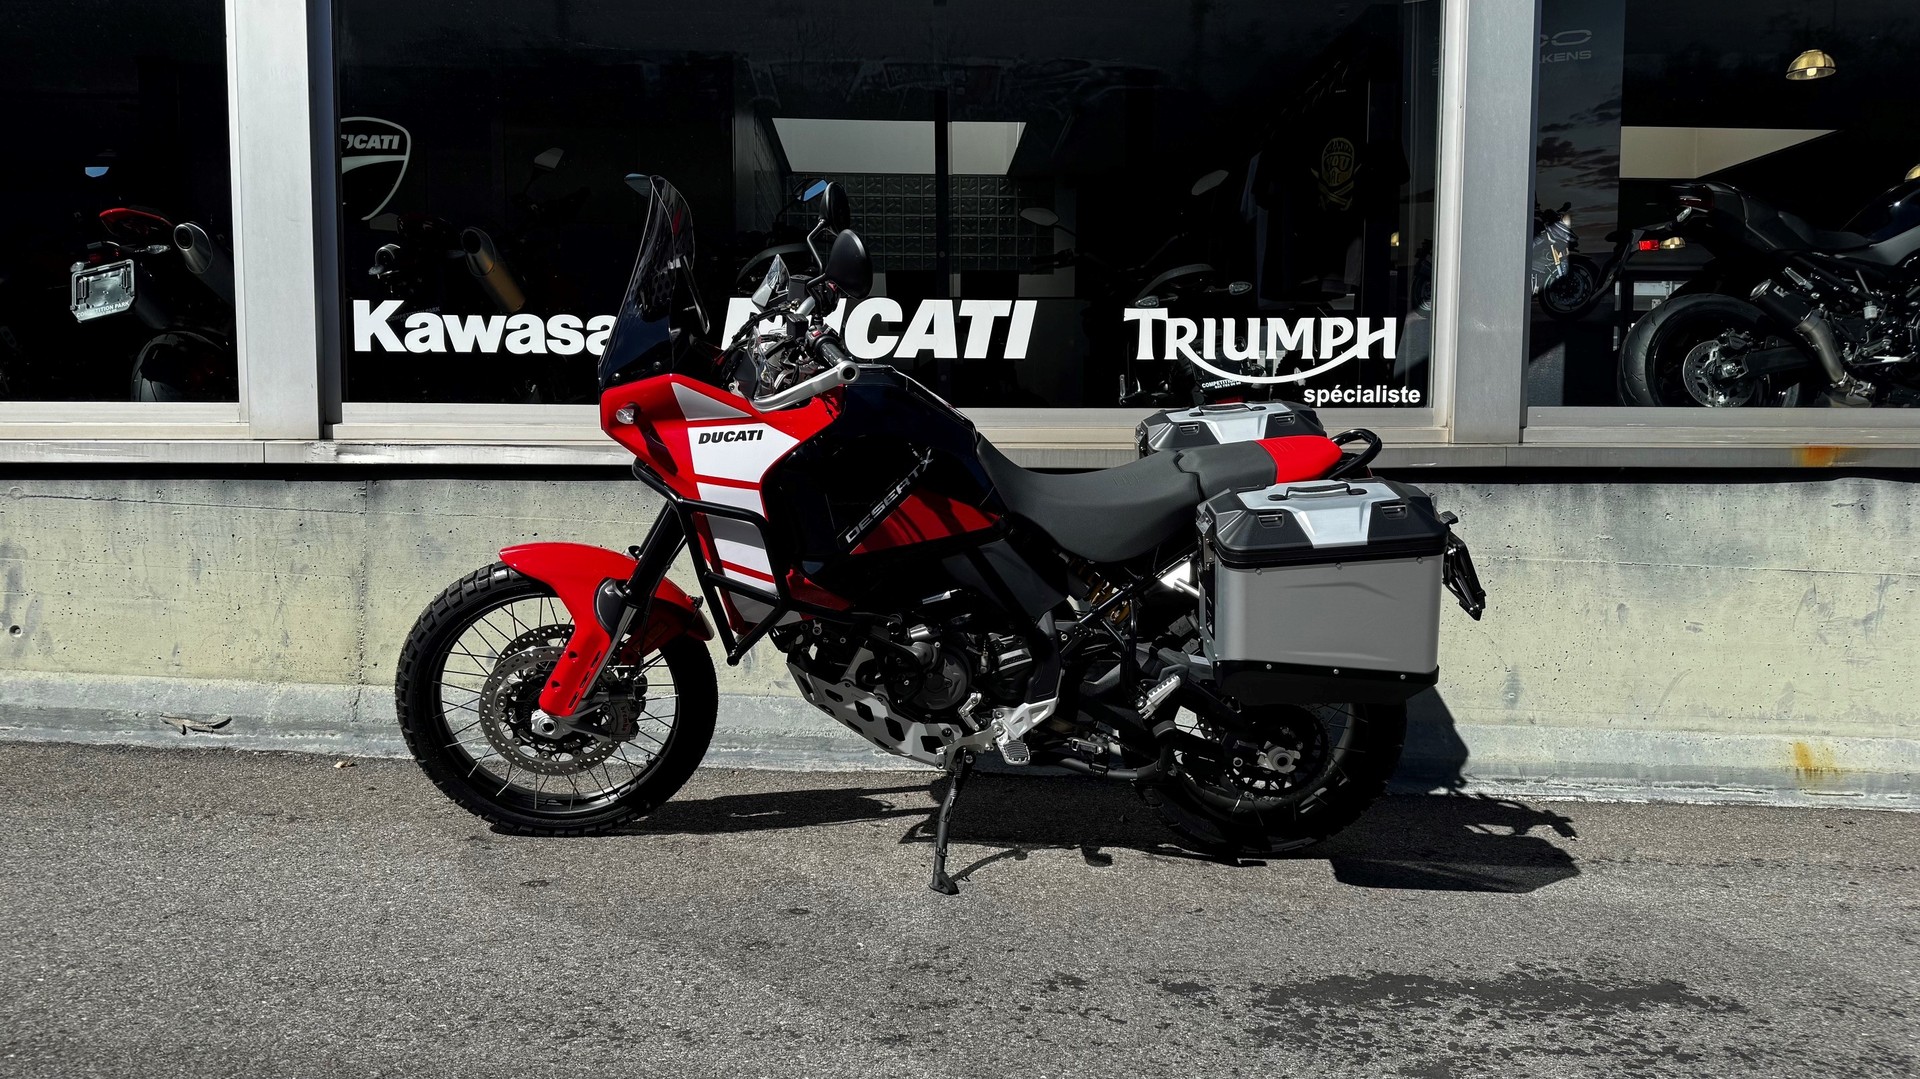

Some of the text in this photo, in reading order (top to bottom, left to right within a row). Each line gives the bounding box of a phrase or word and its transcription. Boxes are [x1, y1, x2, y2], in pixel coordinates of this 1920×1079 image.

[1123, 308, 1397, 384] TRIUMPH
[1303, 385, 1421, 406] spécialiste
[698, 429, 763, 444] DUCATI
